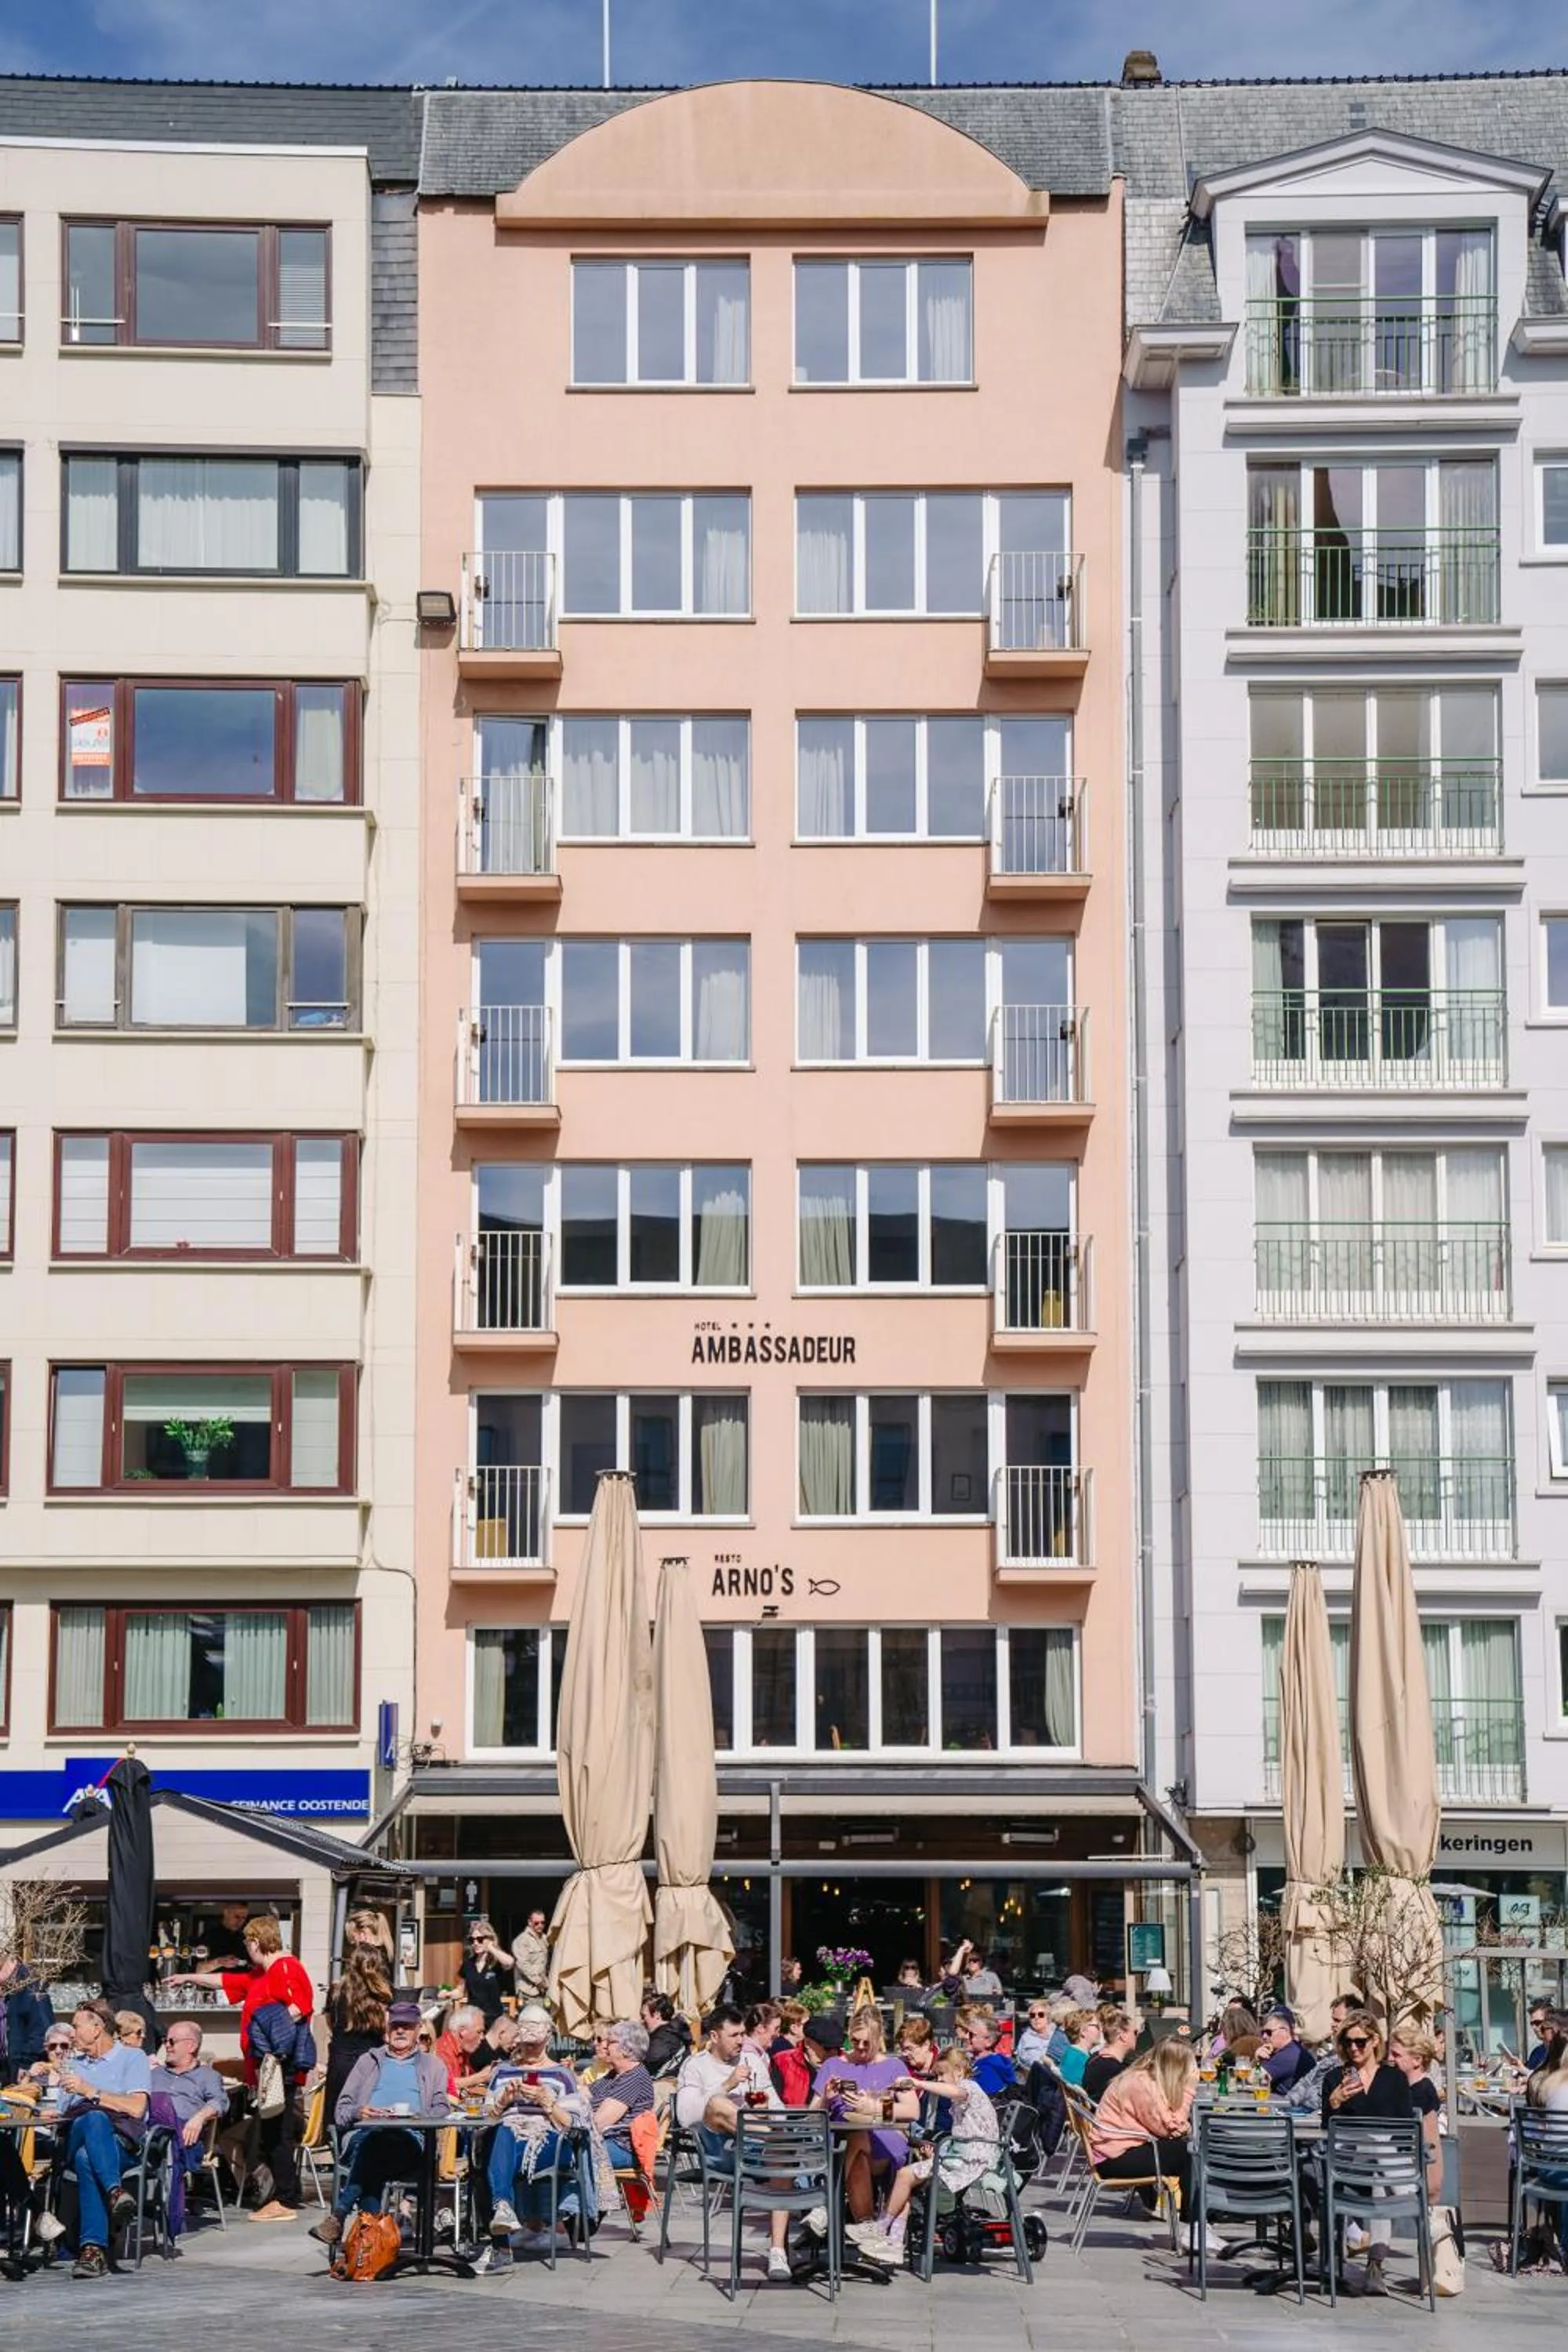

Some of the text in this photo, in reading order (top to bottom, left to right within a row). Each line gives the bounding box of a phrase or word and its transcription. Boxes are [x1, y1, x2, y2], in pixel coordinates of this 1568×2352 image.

[695, 1322, 721, 1330] HOTEL
[691, 1336, 856, 1363] AMBASSADEUR
[714, 1555, 741, 1563] RESTO
[712, 1565, 794, 1596] ARNO'S
[298, 1800, 370, 1810] OOSTENDE
[1438, 1835, 1533, 1854] keringen
